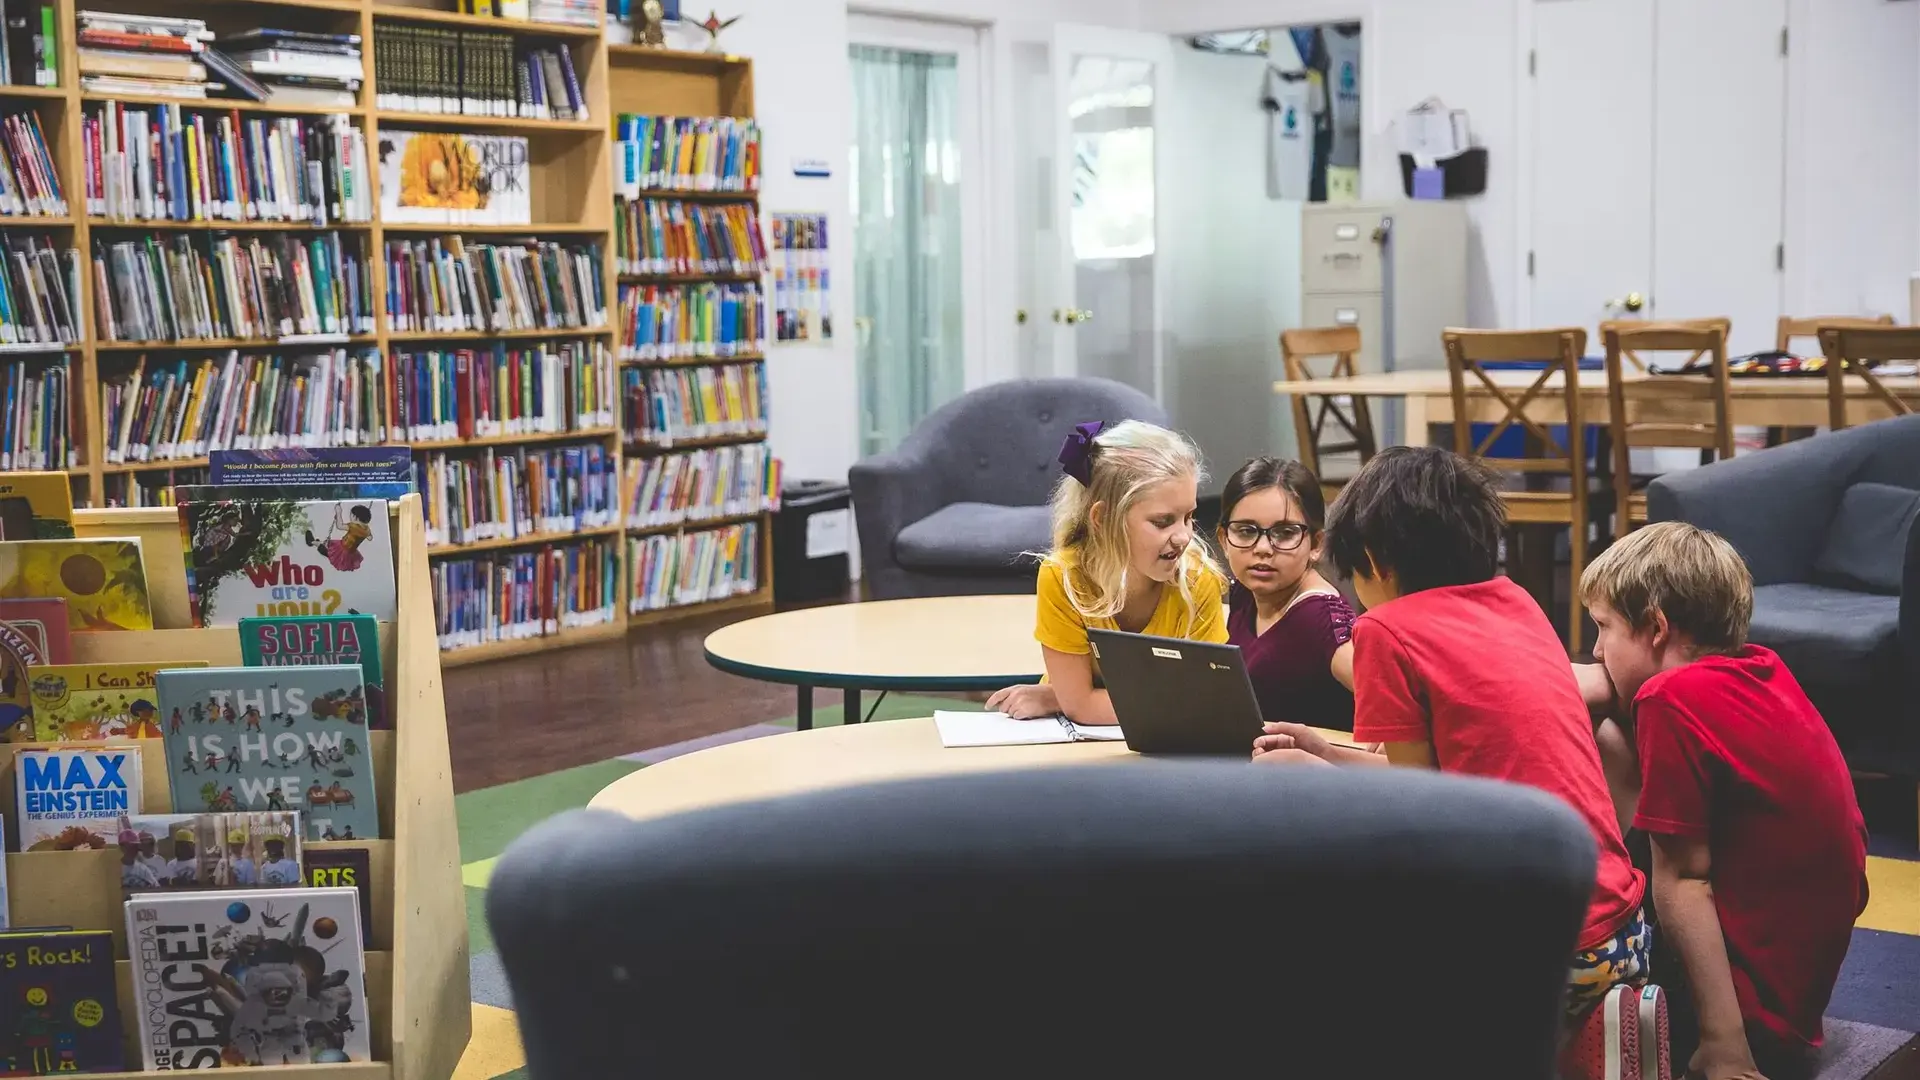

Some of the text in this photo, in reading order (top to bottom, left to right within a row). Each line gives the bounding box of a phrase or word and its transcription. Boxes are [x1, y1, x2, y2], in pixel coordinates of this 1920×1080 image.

[272, 586, 309, 600] are
[258, 622, 361, 655] SOFIA
[86, 673, 90, 688] I
[97, 672, 130, 687] Can
[210, 687, 309, 718] THIS
[188, 731, 342, 762] IS HOW
[23, 754, 127, 791] MAX
[26, 790, 128, 812] EINSTEIN
[238, 776, 303, 805] WE
[27, 810, 128, 820] THE GENIUS EXPERIMENT
[313, 867, 356, 888] RTS
[27, 943, 91, 966] Rock!
[140, 925, 169, 1046] ENCYCLOPEDIA
[156, 923, 222, 1069] SPACE!
